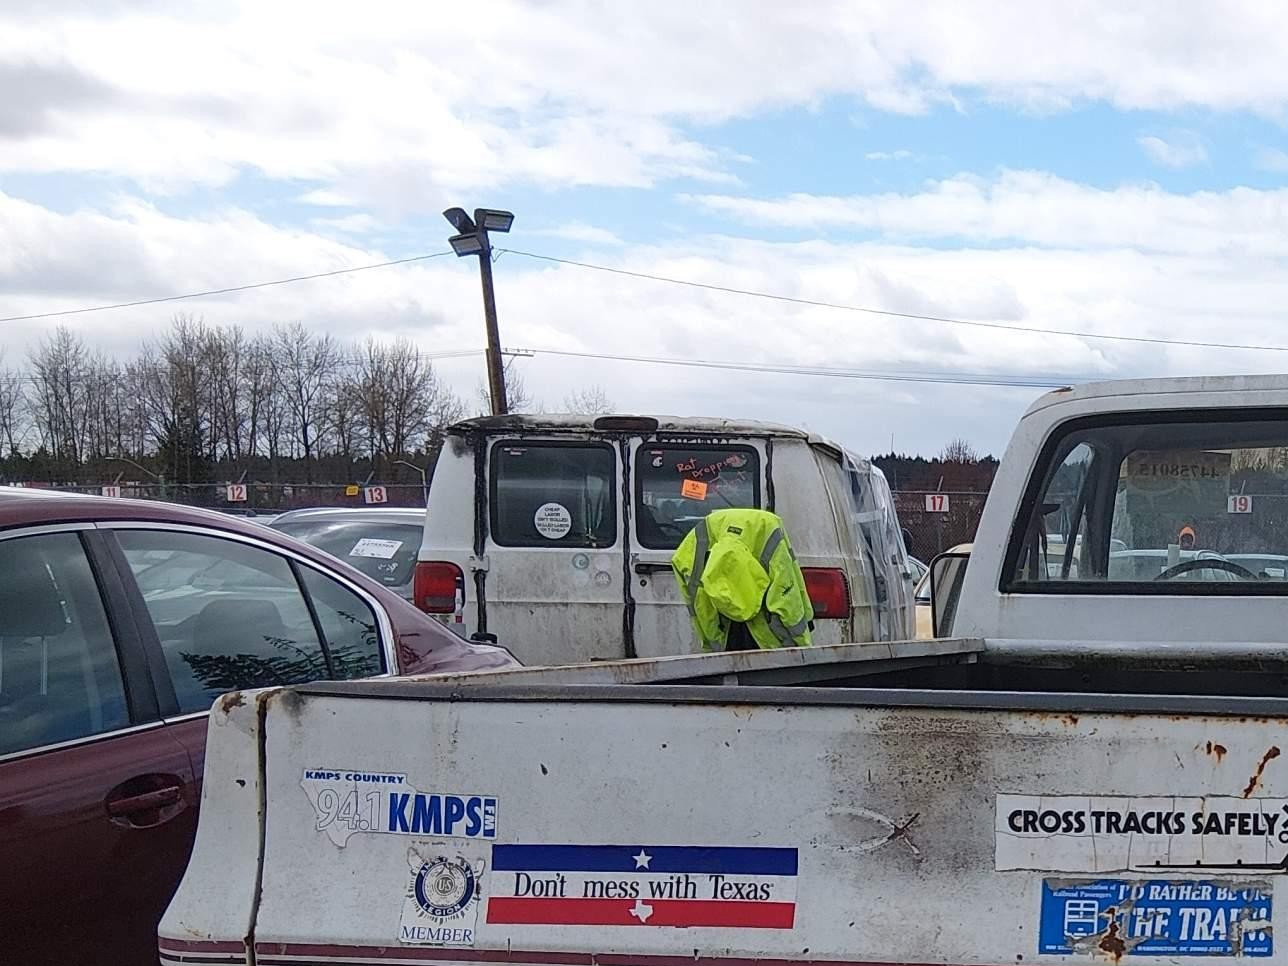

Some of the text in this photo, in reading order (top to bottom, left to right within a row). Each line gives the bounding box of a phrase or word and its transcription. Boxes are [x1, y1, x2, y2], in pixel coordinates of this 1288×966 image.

[677, 458, 697, 473] Rat
[105, 487, 116, 498] 11
[231, 486, 243, 500] 12
[369, 487, 384, 502] 13
[931, 495, 945, 511] 17
[1232, 496, 1248, 512] 19
[305, 771, 404, 784] KMPS COUNTRY
[316, 788, 496, 837] 94.1 KMPS FM
[1008, 809, 1280, 836] CROSS TRACKS SAFELY
[513, 872, 771, 901] Don't mess with Texas
[1149, 884, 1212, 901] RATHER
[422, 902, 461, 916] LEGION
[401, 926, 473, 942] MEMBER
